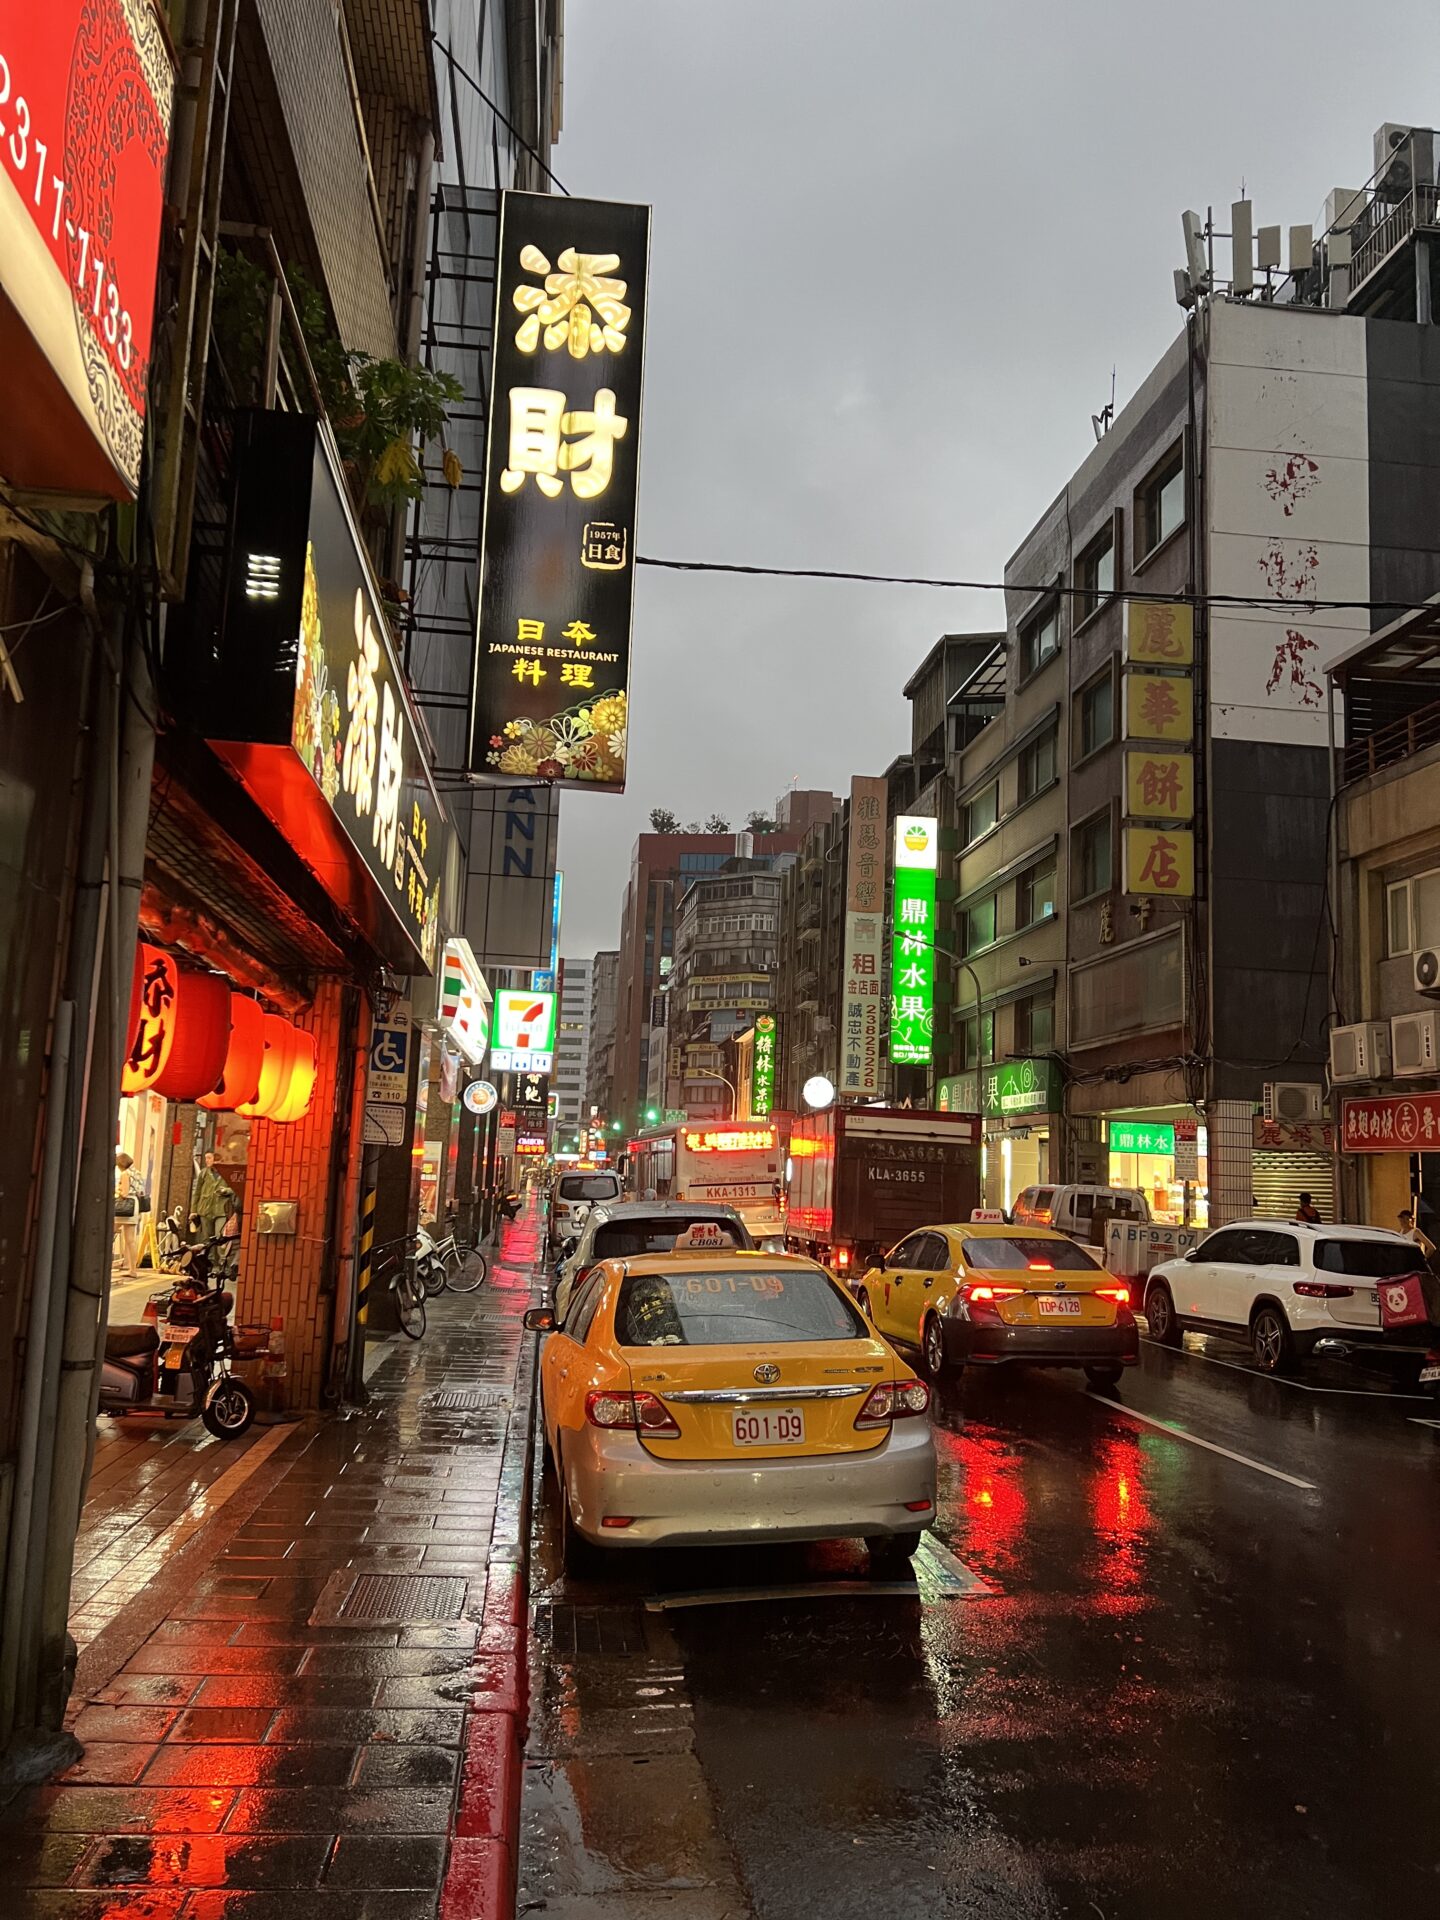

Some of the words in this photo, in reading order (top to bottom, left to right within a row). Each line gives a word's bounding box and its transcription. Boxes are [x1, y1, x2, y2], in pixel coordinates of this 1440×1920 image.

[590, 530, 621, 541] 1957年
[488, 643, 545, 656] JAPANESE
[546, 647, 619, 663] RESTAURANT
[1135, 605, 1185, 890] 麗華餅店
[852, 952, 876, 975] 租
[898, 898, 929, 1022] 鼎林水果
[846, 980, 880, 996] 金店面
[844, 1002, 863, 1088] 誠忠不動產
[863, 1004, 878, 1088] 23825228
[386, 1092, 401, 1100] 110
[1421, 1106, 1440, 1139] 魯
[868, 1167, 926, 1183] KLA-3655
[706, 1186, 757, 1198] KKA-1313
[1039, 1301, 1081, 1313] TDP-6128
[735, 1414, 801, 1440] 601-D9
